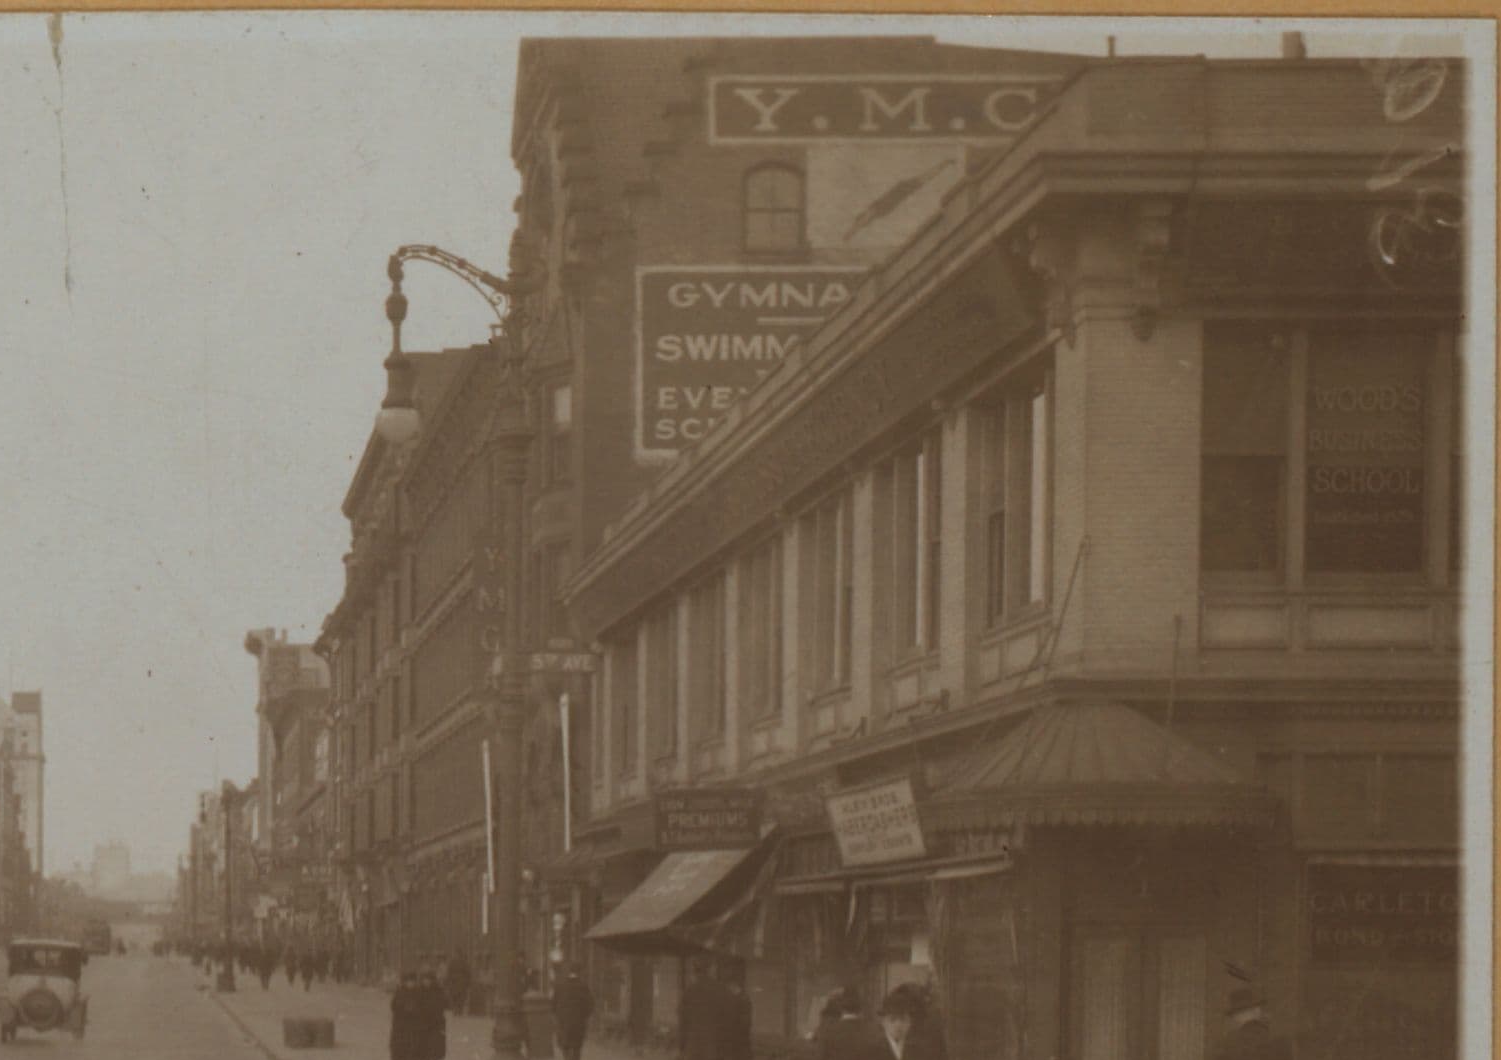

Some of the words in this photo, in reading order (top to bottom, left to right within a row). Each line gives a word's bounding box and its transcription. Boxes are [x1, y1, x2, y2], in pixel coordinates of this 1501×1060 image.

[1313, 378, 1421, 413] WOOD'S
[1308, 428, 1422, 452] BUSINESS
[1312, 466, 1420, 495] SCHOOL
[561, 655, 596, 671] AVE
[666, 811, 749, 829] PREMIUMS
